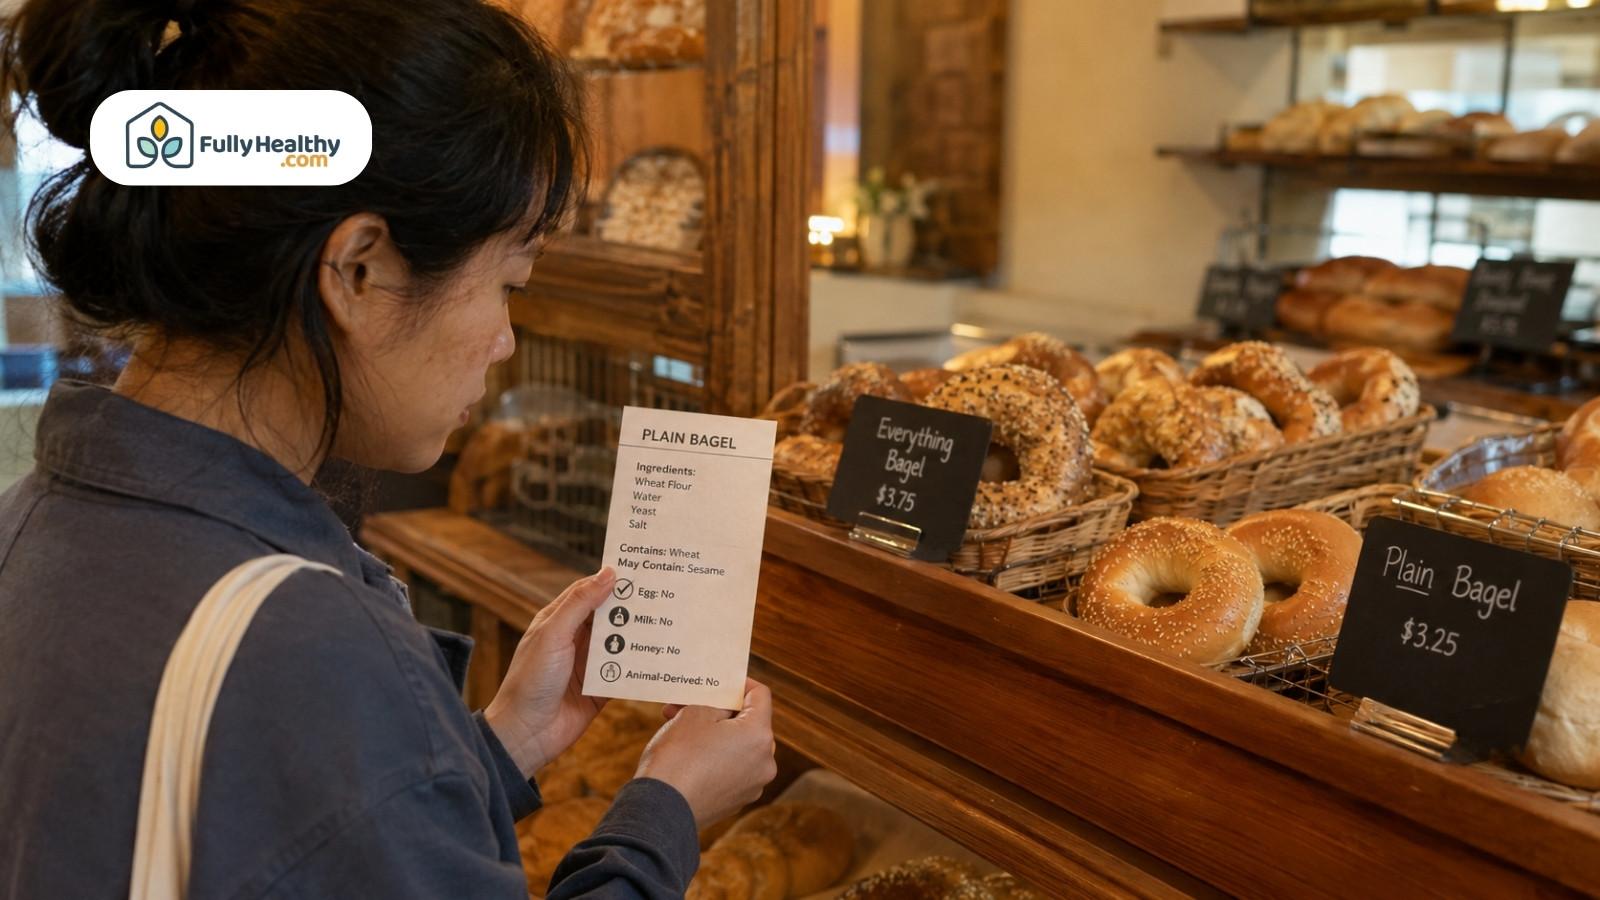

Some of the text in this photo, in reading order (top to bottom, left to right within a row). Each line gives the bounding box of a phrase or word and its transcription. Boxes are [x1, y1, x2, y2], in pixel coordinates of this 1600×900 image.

[642, 428, 737, 450] PLAIN BAGEL
[876, 416, 954, 463] Everything
[636, 462, 696, 476] Ingredients:
[884, 448, 926, 484] Bagel
[634, 477, 692, 491] Wheat Flour
[632, 491, 662, 503] Water
[876, 484, 917, 512] $3.75
[631, 505, 657, 517] Yeast
[629, 519, 647, 530] Salt
[619, 543, 700, 559] Contains: Wheat
[617, 557, 726, 576] May Contain: Sesame
[1383, 545, 1522, 620] Plain Bagel
[638, 587, 675, 599] Egg: No
[633, 614, 673, 627] Milk: No
[1400, 617, 1460, 656] $3.25
[630, 642, 681, 655] Honey: No
[625, 669, 720, 687] Animal-Derived: No
